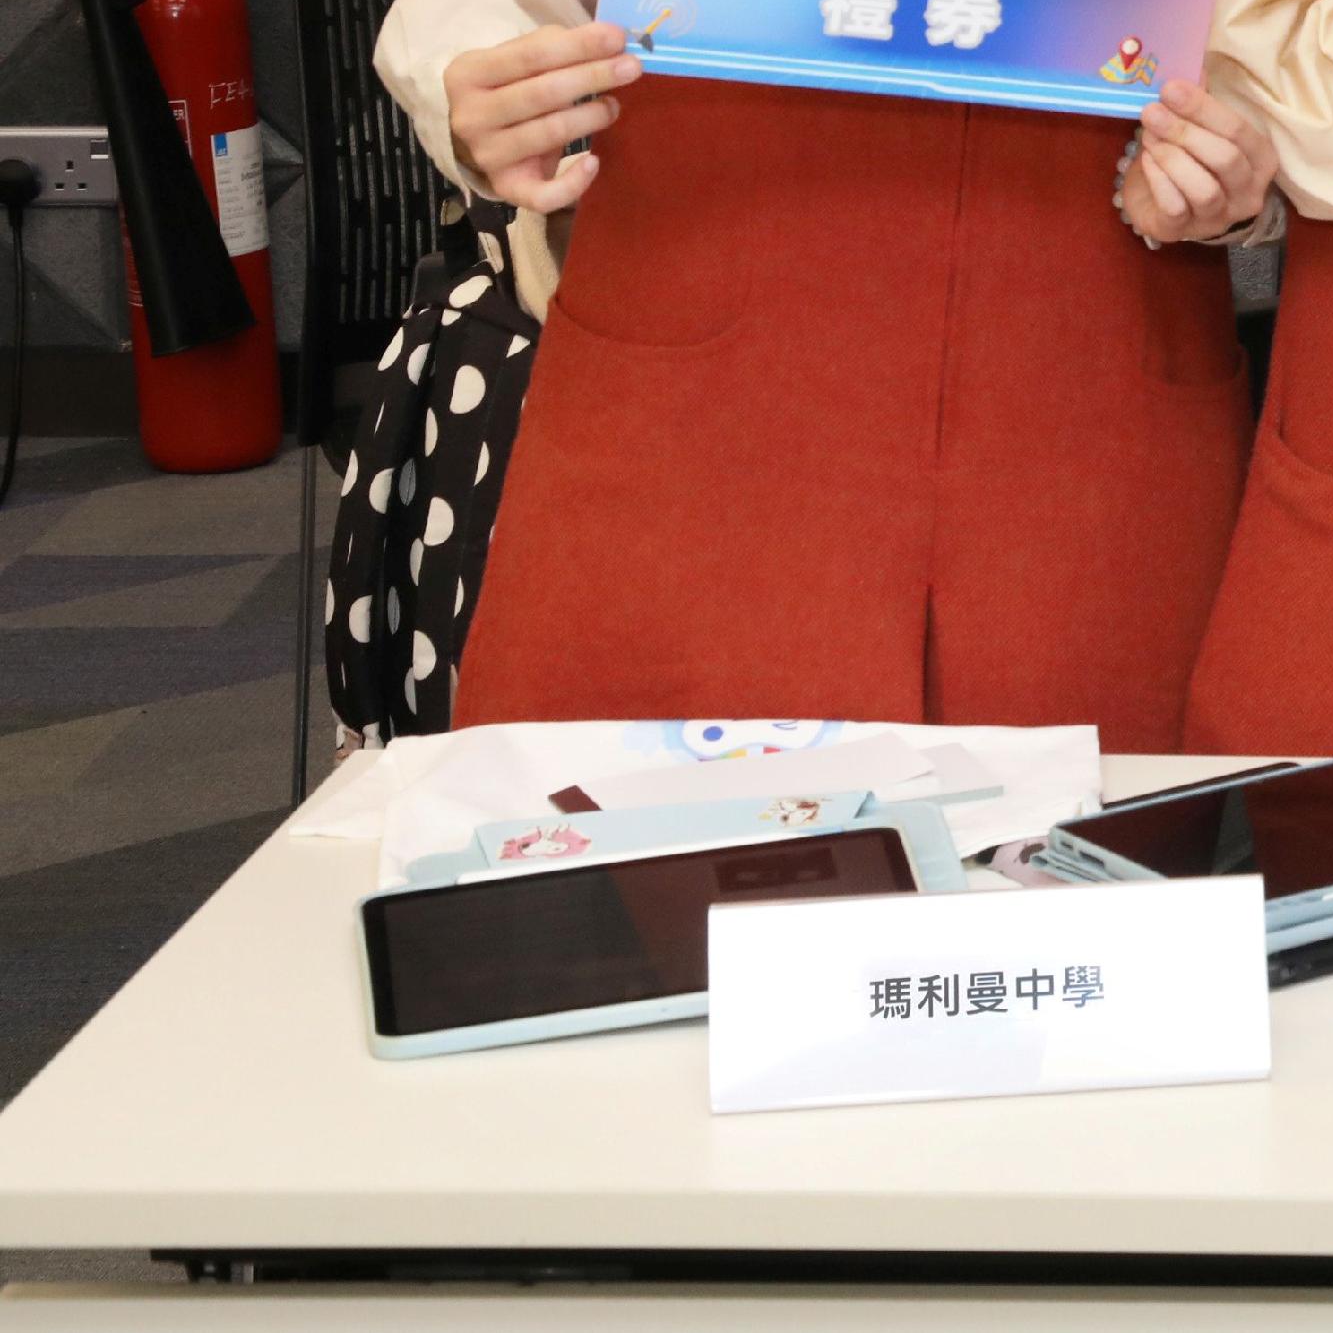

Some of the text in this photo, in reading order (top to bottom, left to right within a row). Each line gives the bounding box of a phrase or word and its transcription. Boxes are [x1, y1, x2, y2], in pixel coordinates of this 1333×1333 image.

[869, 966, 1104, 1019] 瑪利曼中學
